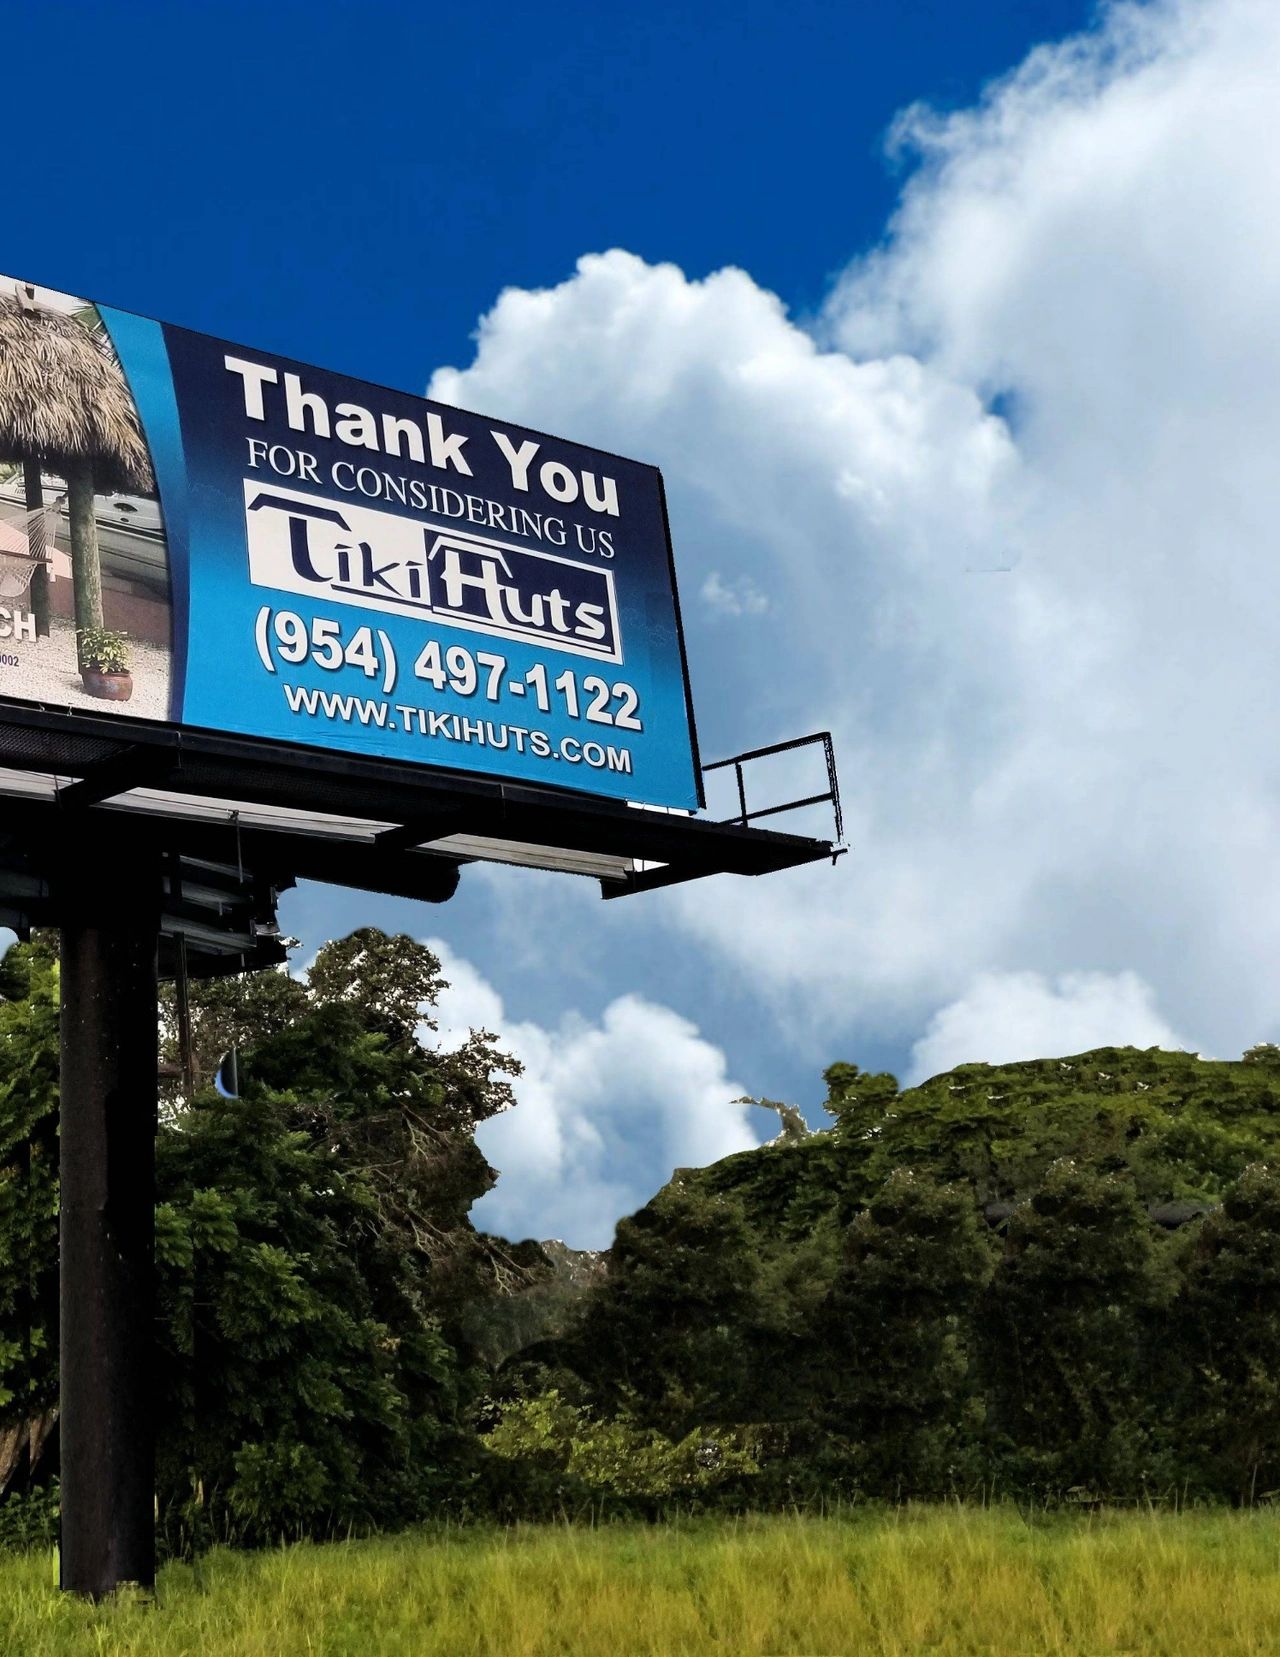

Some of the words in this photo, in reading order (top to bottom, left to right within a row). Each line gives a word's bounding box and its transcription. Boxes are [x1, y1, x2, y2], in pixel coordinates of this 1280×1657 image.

[224, 355, 473, 476] Thank
[490, 430, 621, 517] You
[245, 437, 322, 485] FOR
[331, 461, 567, 546] CONSIDERING
[575, 523, 616, 559] US
[255, 605, 397, 694] (954)
[414, 640, 642, 731] 497-1122
[283, 683, 632, 774] WWW.TIKIHUTS.COM
